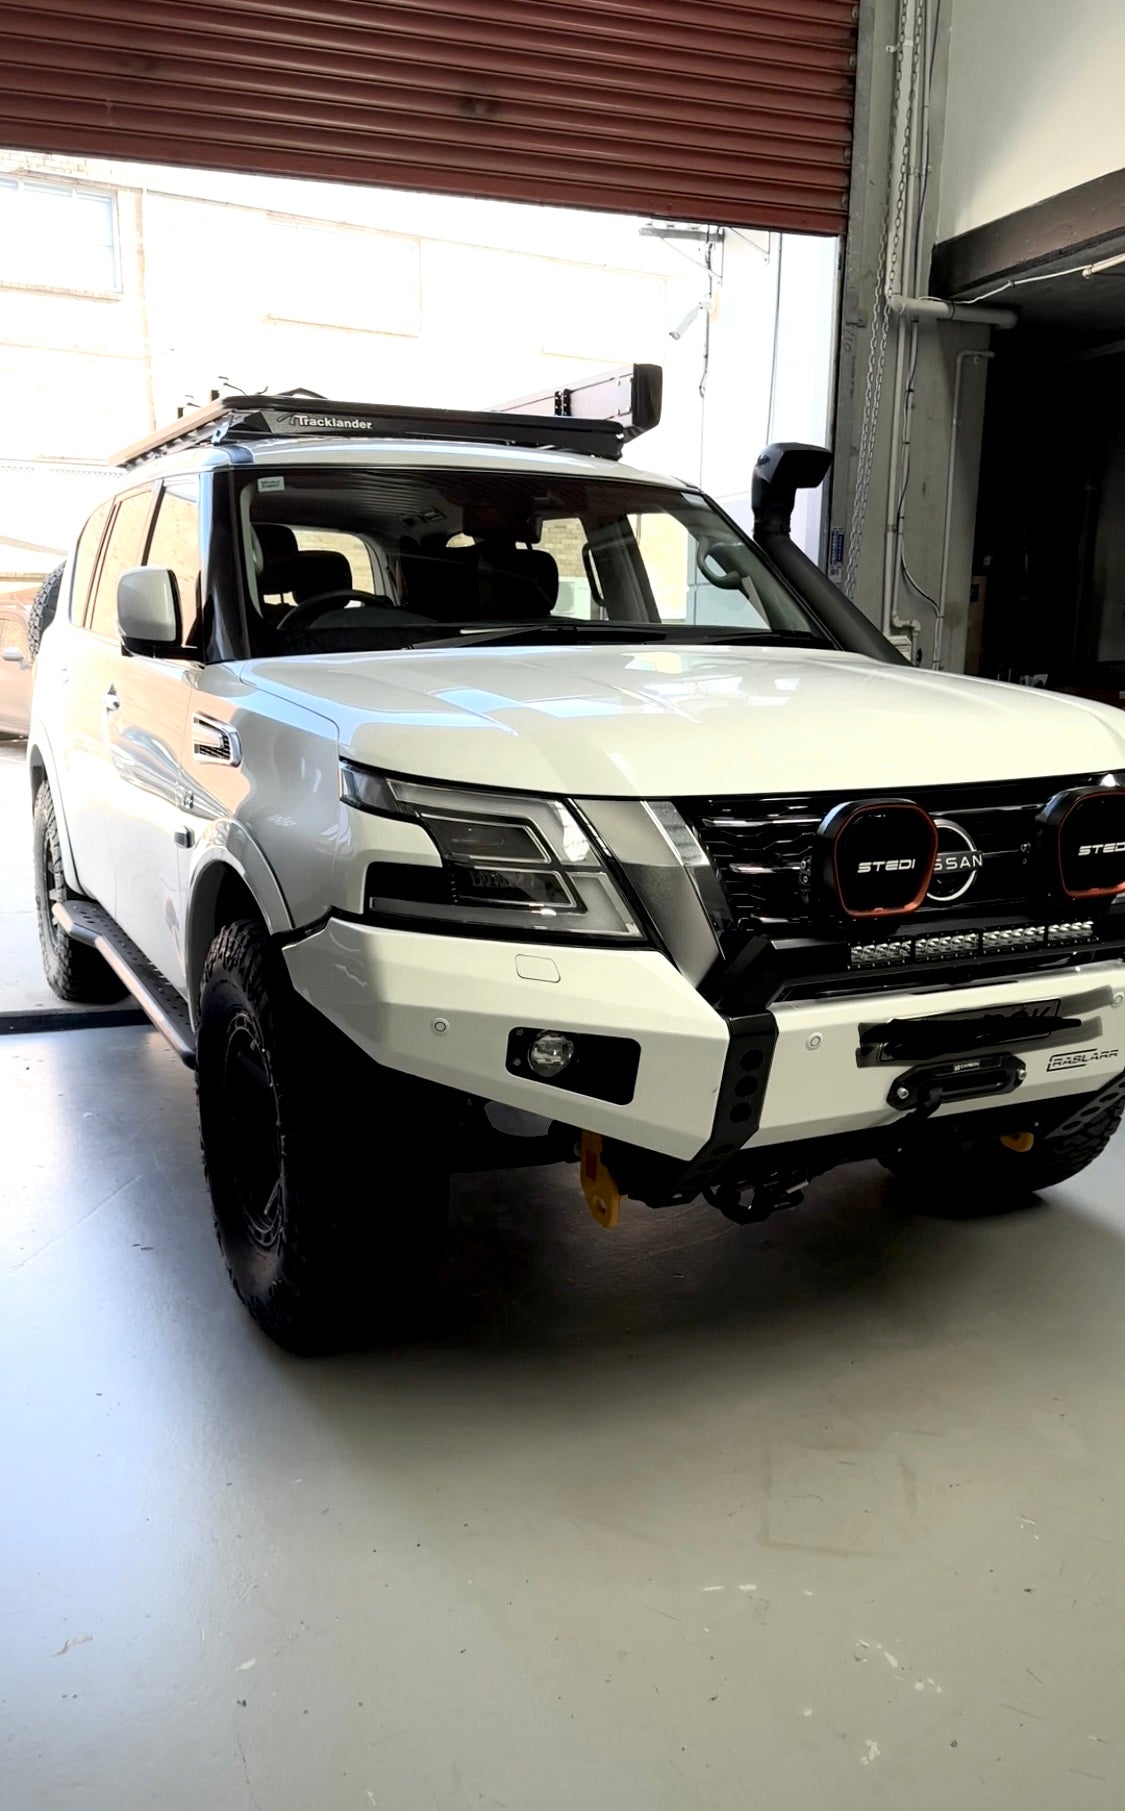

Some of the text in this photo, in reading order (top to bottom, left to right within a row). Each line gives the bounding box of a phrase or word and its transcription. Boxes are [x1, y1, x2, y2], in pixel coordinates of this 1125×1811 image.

[295, 414, 373, 429] Tracklander
[1077, 841, 1125, 857] STED
[857, 858, 916, 874] STEDI
[933, 854, 983, 872] SSAN
[1051, 1049, 1119, 1067] RASLARR
